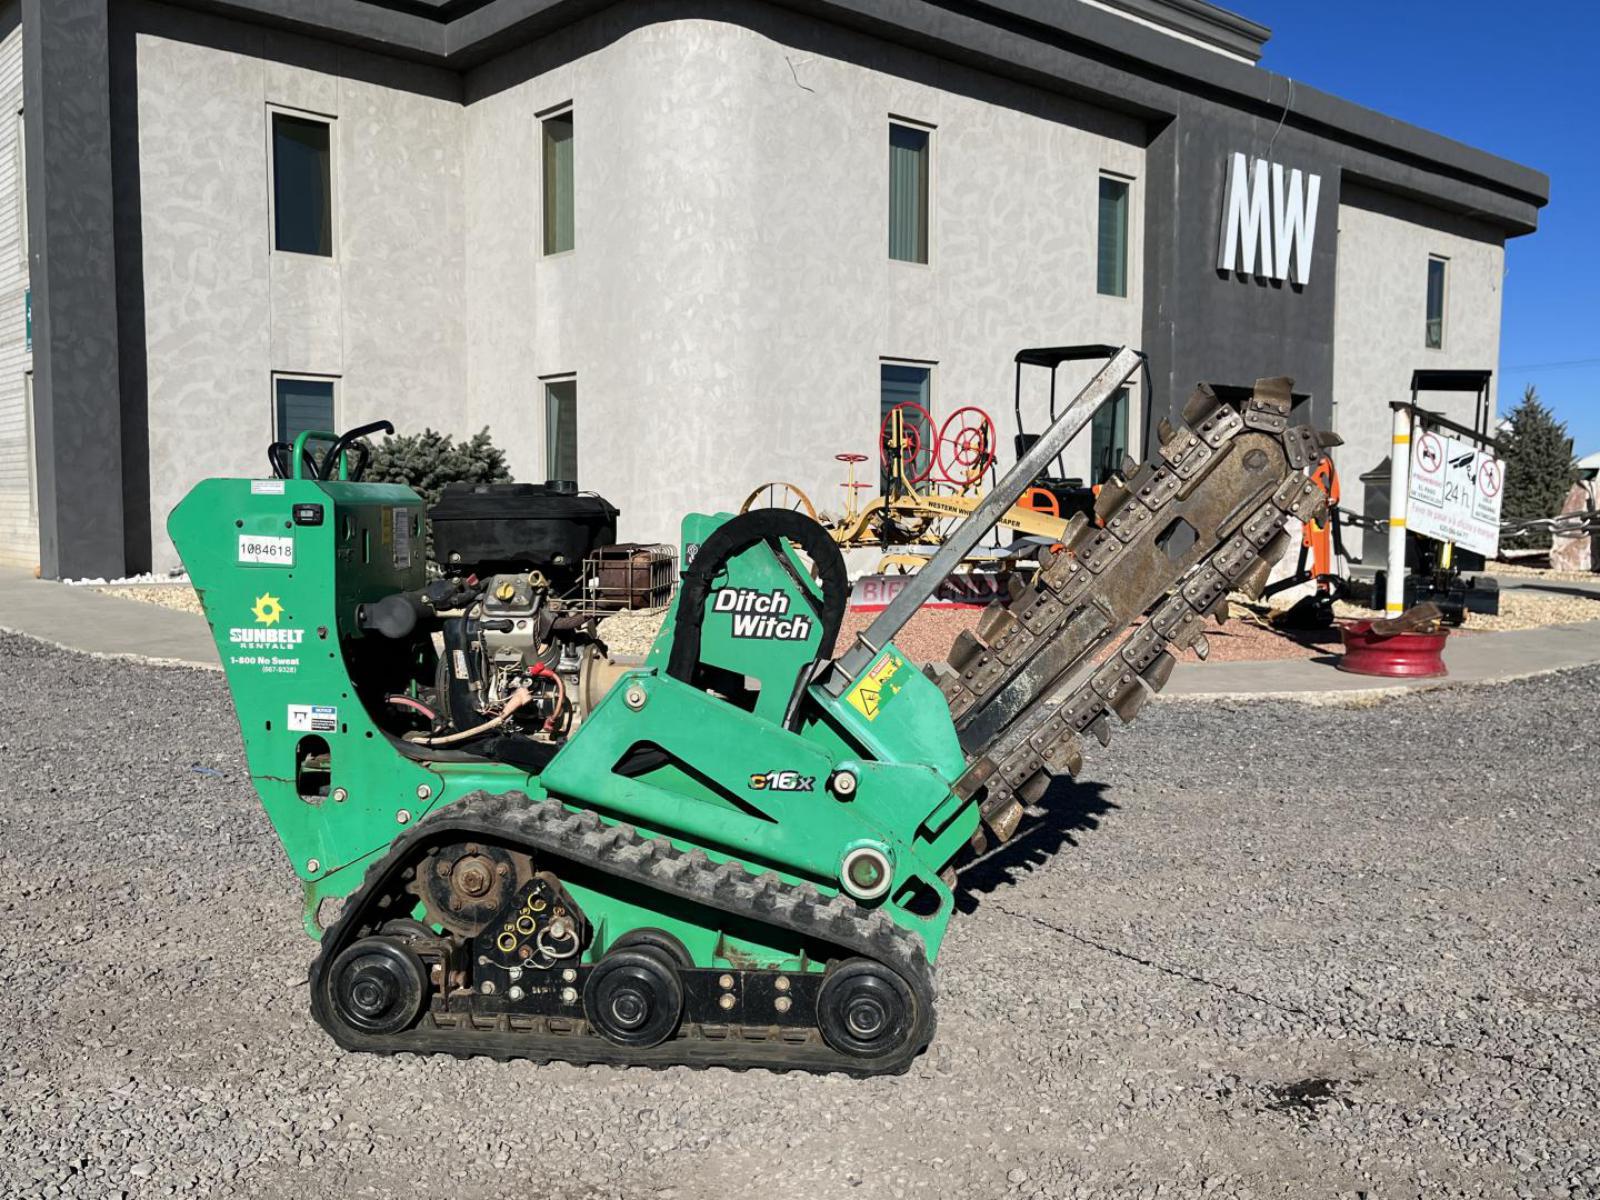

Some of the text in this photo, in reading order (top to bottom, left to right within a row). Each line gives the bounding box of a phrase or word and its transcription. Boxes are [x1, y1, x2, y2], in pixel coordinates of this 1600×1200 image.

[1219, 151, 1321, 286] MW
[1444, 480, 1458, 503] 24
[928, 501, 958, 513] WESTERN
[999, 517, 1021, 527] RAPER
[241, 543, 292, 557] 1084618
[715, 588, 788, 613] Ditch
[229, 628, 305, 643] SUNBELT
[733, 614, 809, 639] Witch
[240, 642, 294, 650] RENTALS
[230, 656, 300, 666] 1-800 No Sweat
